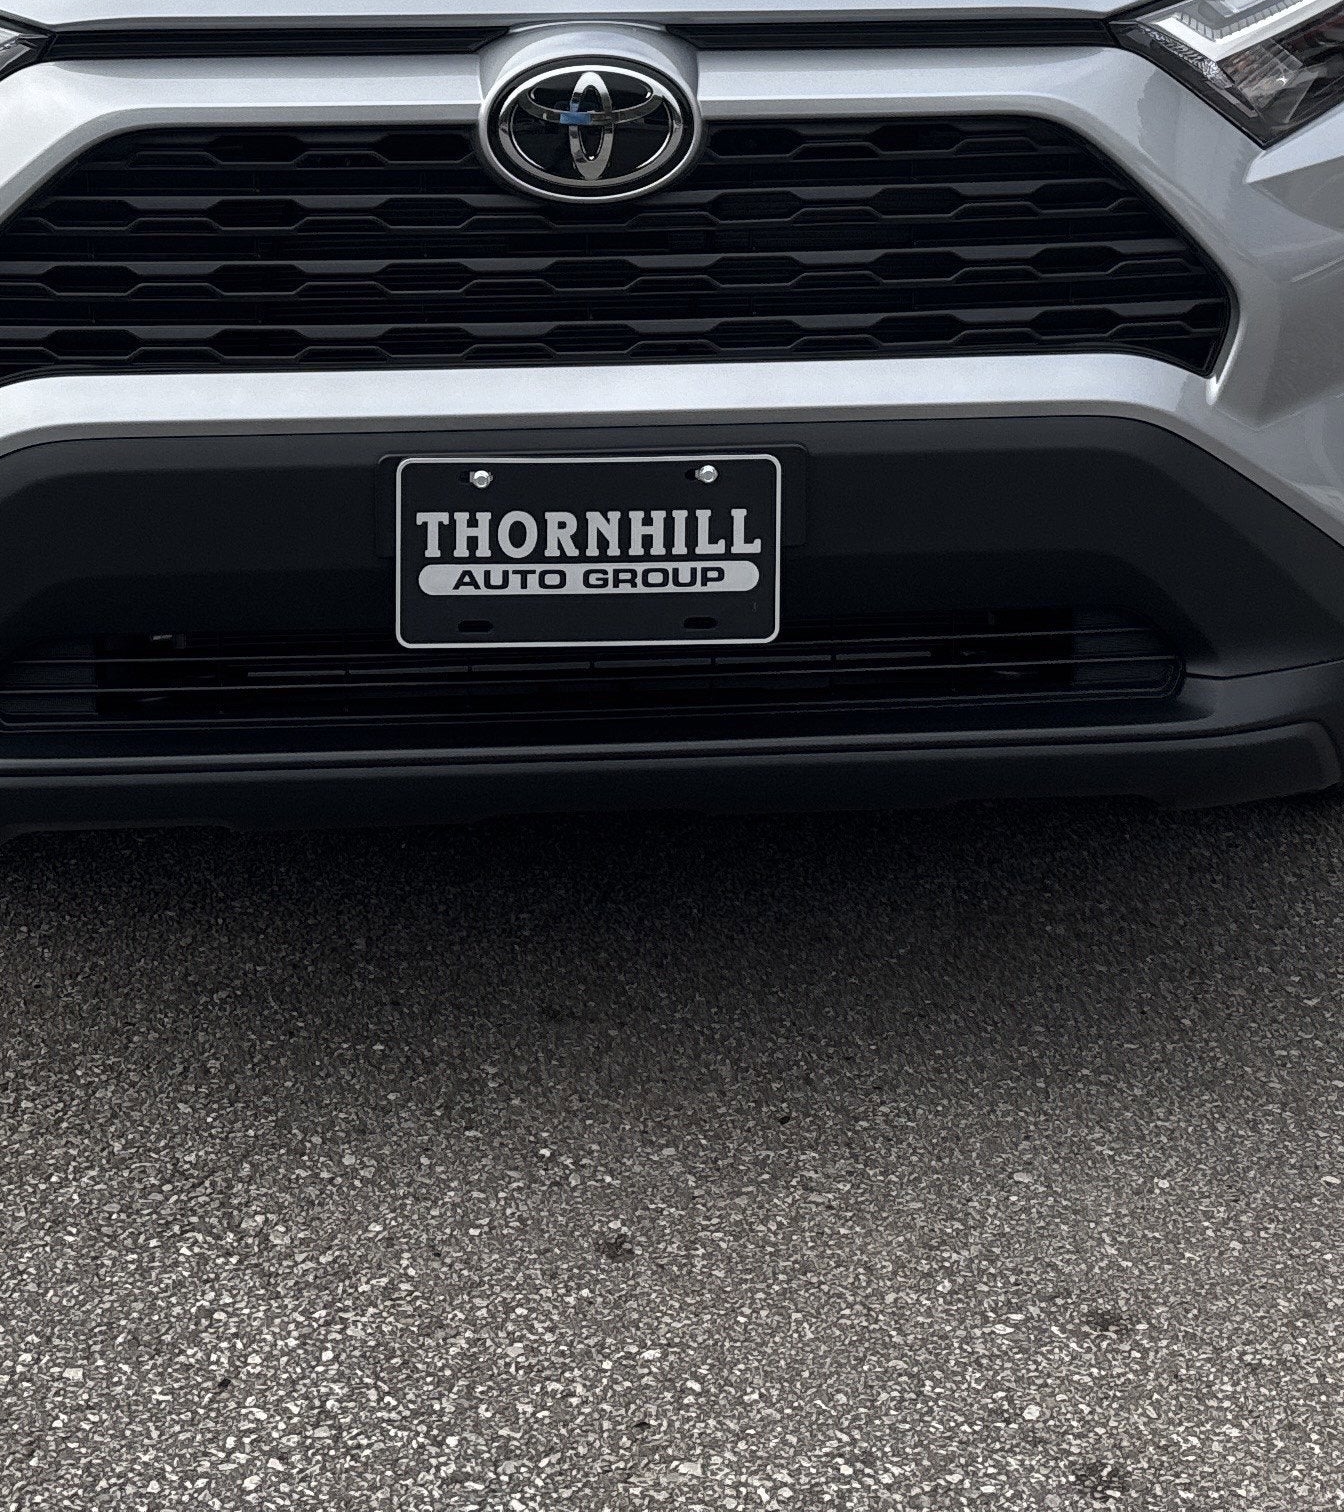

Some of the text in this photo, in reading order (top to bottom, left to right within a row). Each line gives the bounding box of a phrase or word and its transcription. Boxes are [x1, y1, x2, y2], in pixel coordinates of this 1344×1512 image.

[415, 507, 762, 559] THORNHILL
[452, 565, 725, 590] AUTO GROUP
